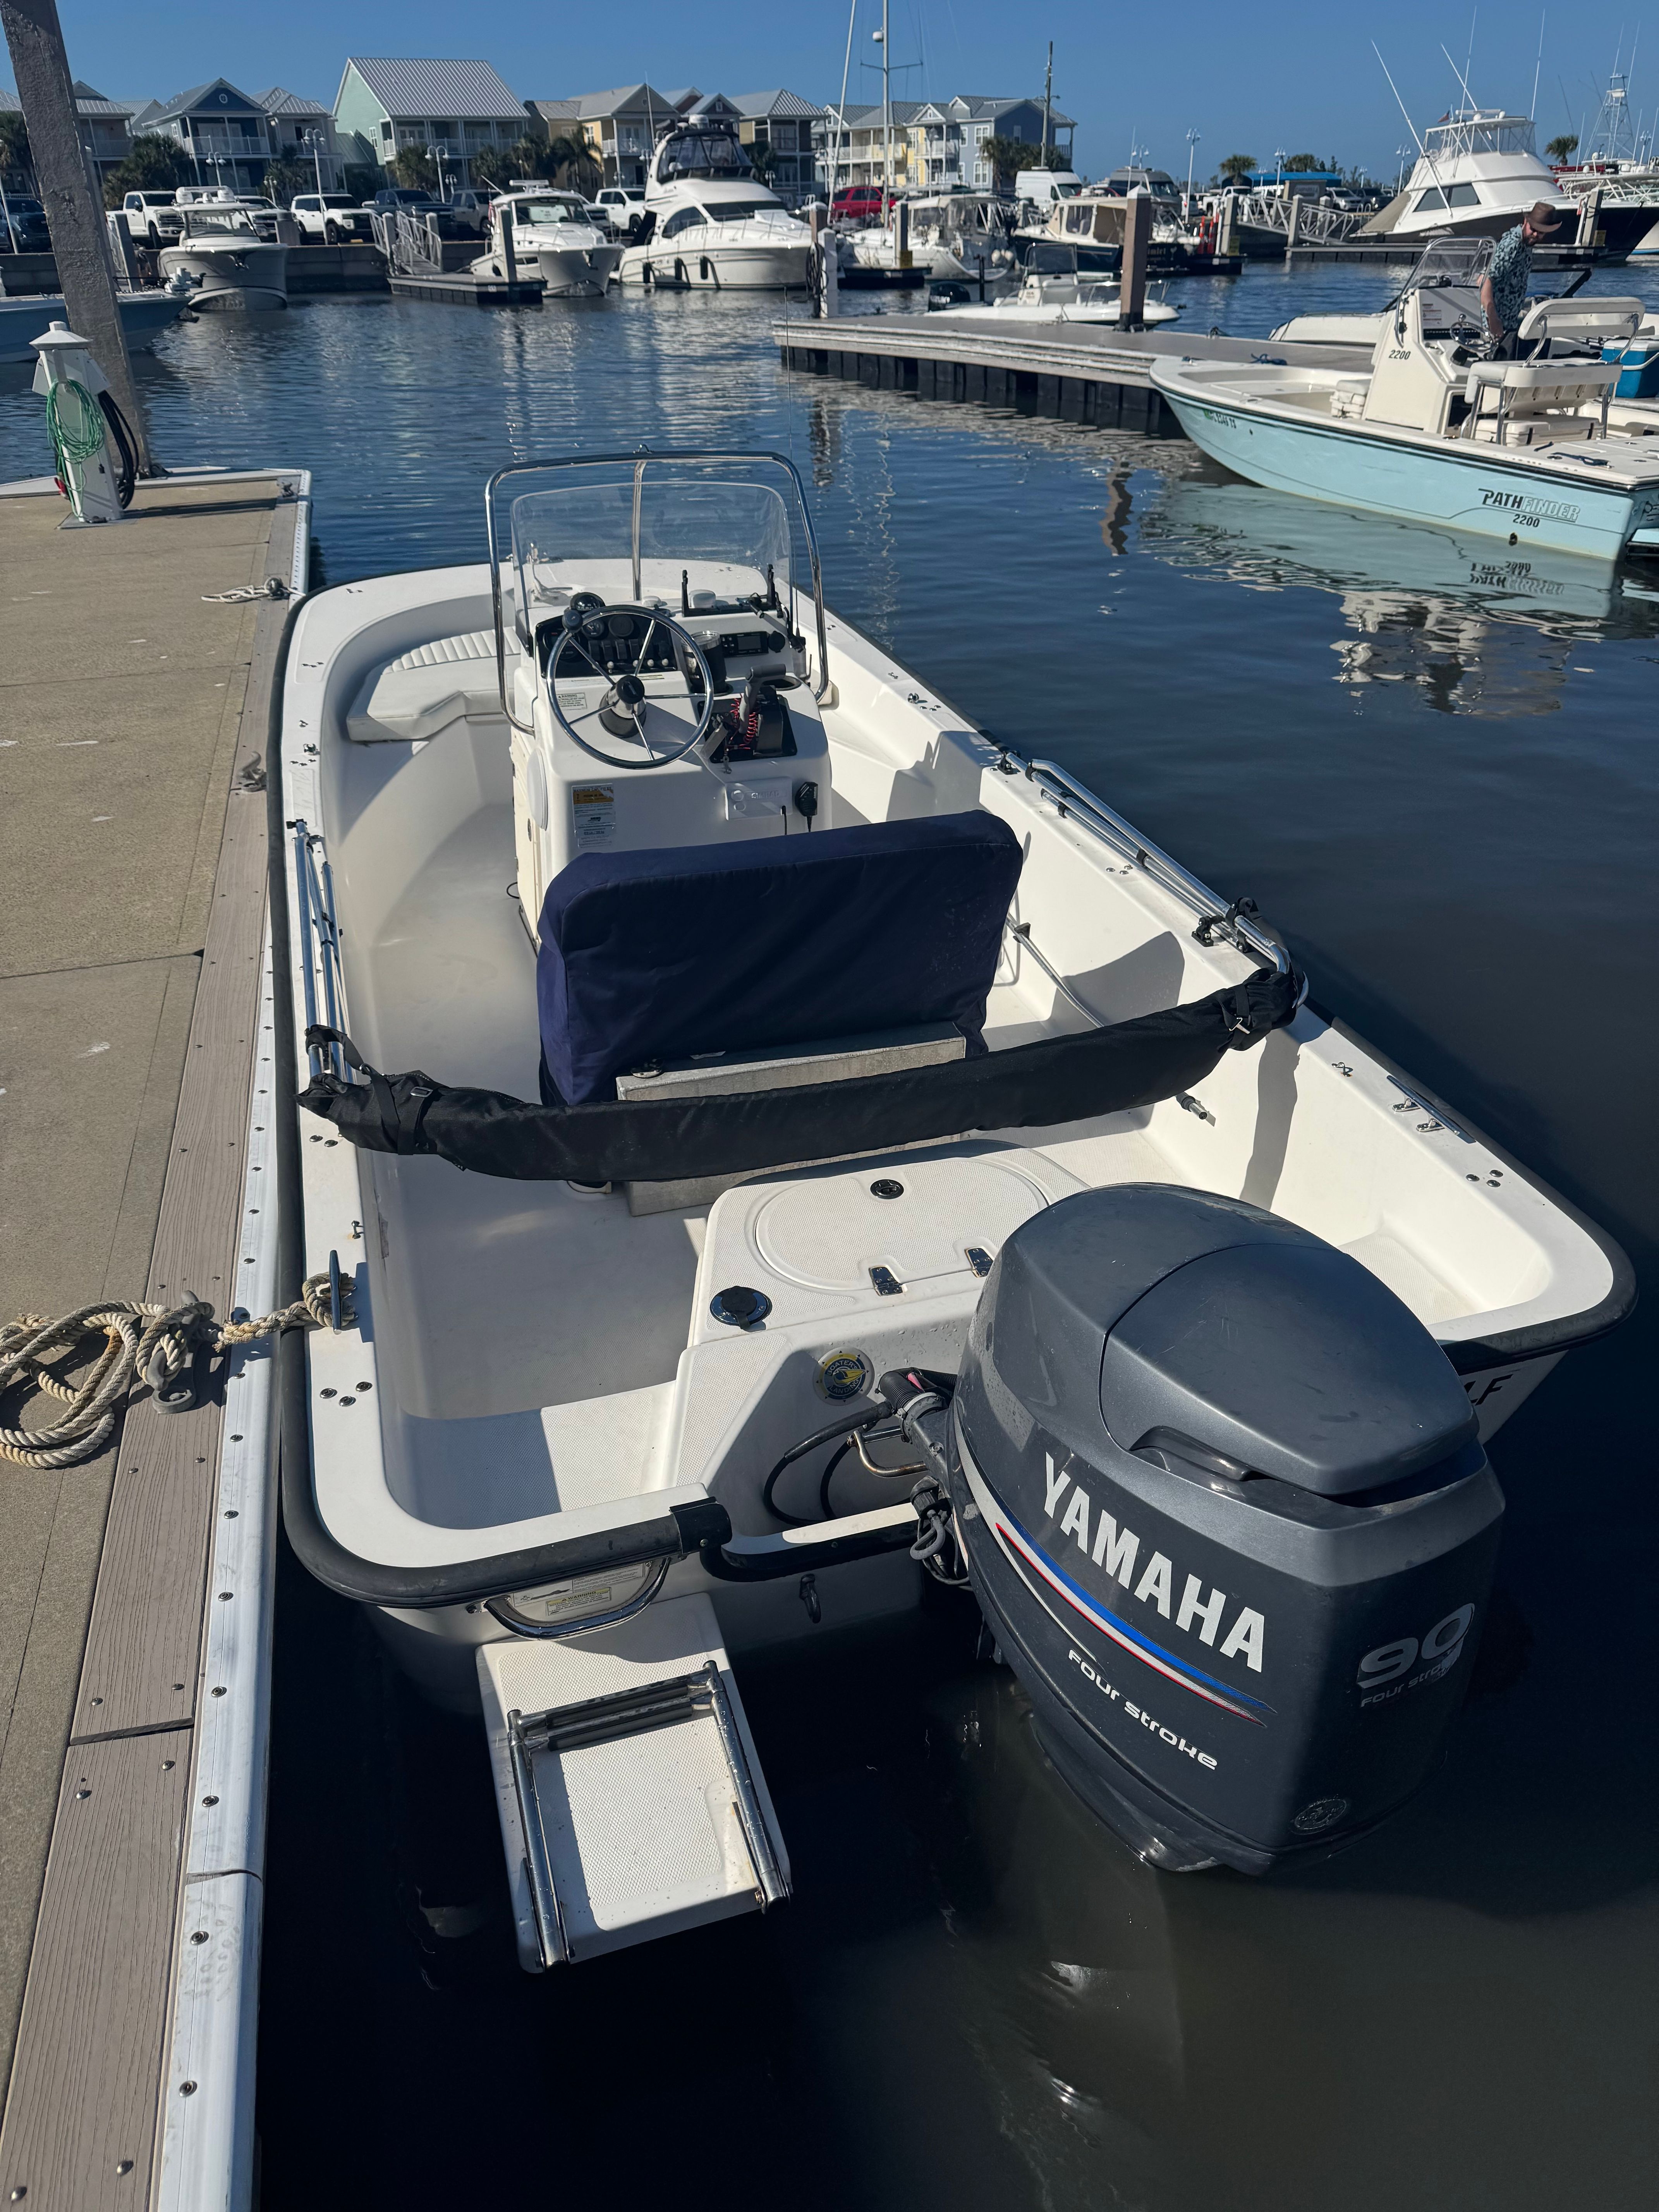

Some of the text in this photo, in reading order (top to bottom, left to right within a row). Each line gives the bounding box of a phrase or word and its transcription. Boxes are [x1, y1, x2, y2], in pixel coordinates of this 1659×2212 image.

[1389, 350, 1411, 360] 2200
[1479, 488, 1580, 521] PATHFINDER
[1513, 514, 1540, 527] 2200
[830, 1379, 859, 1393] LANDING
[1044, 1451, 1265, 1673] YAMAHA
[1357, 1603, 1475, 1689] 90
